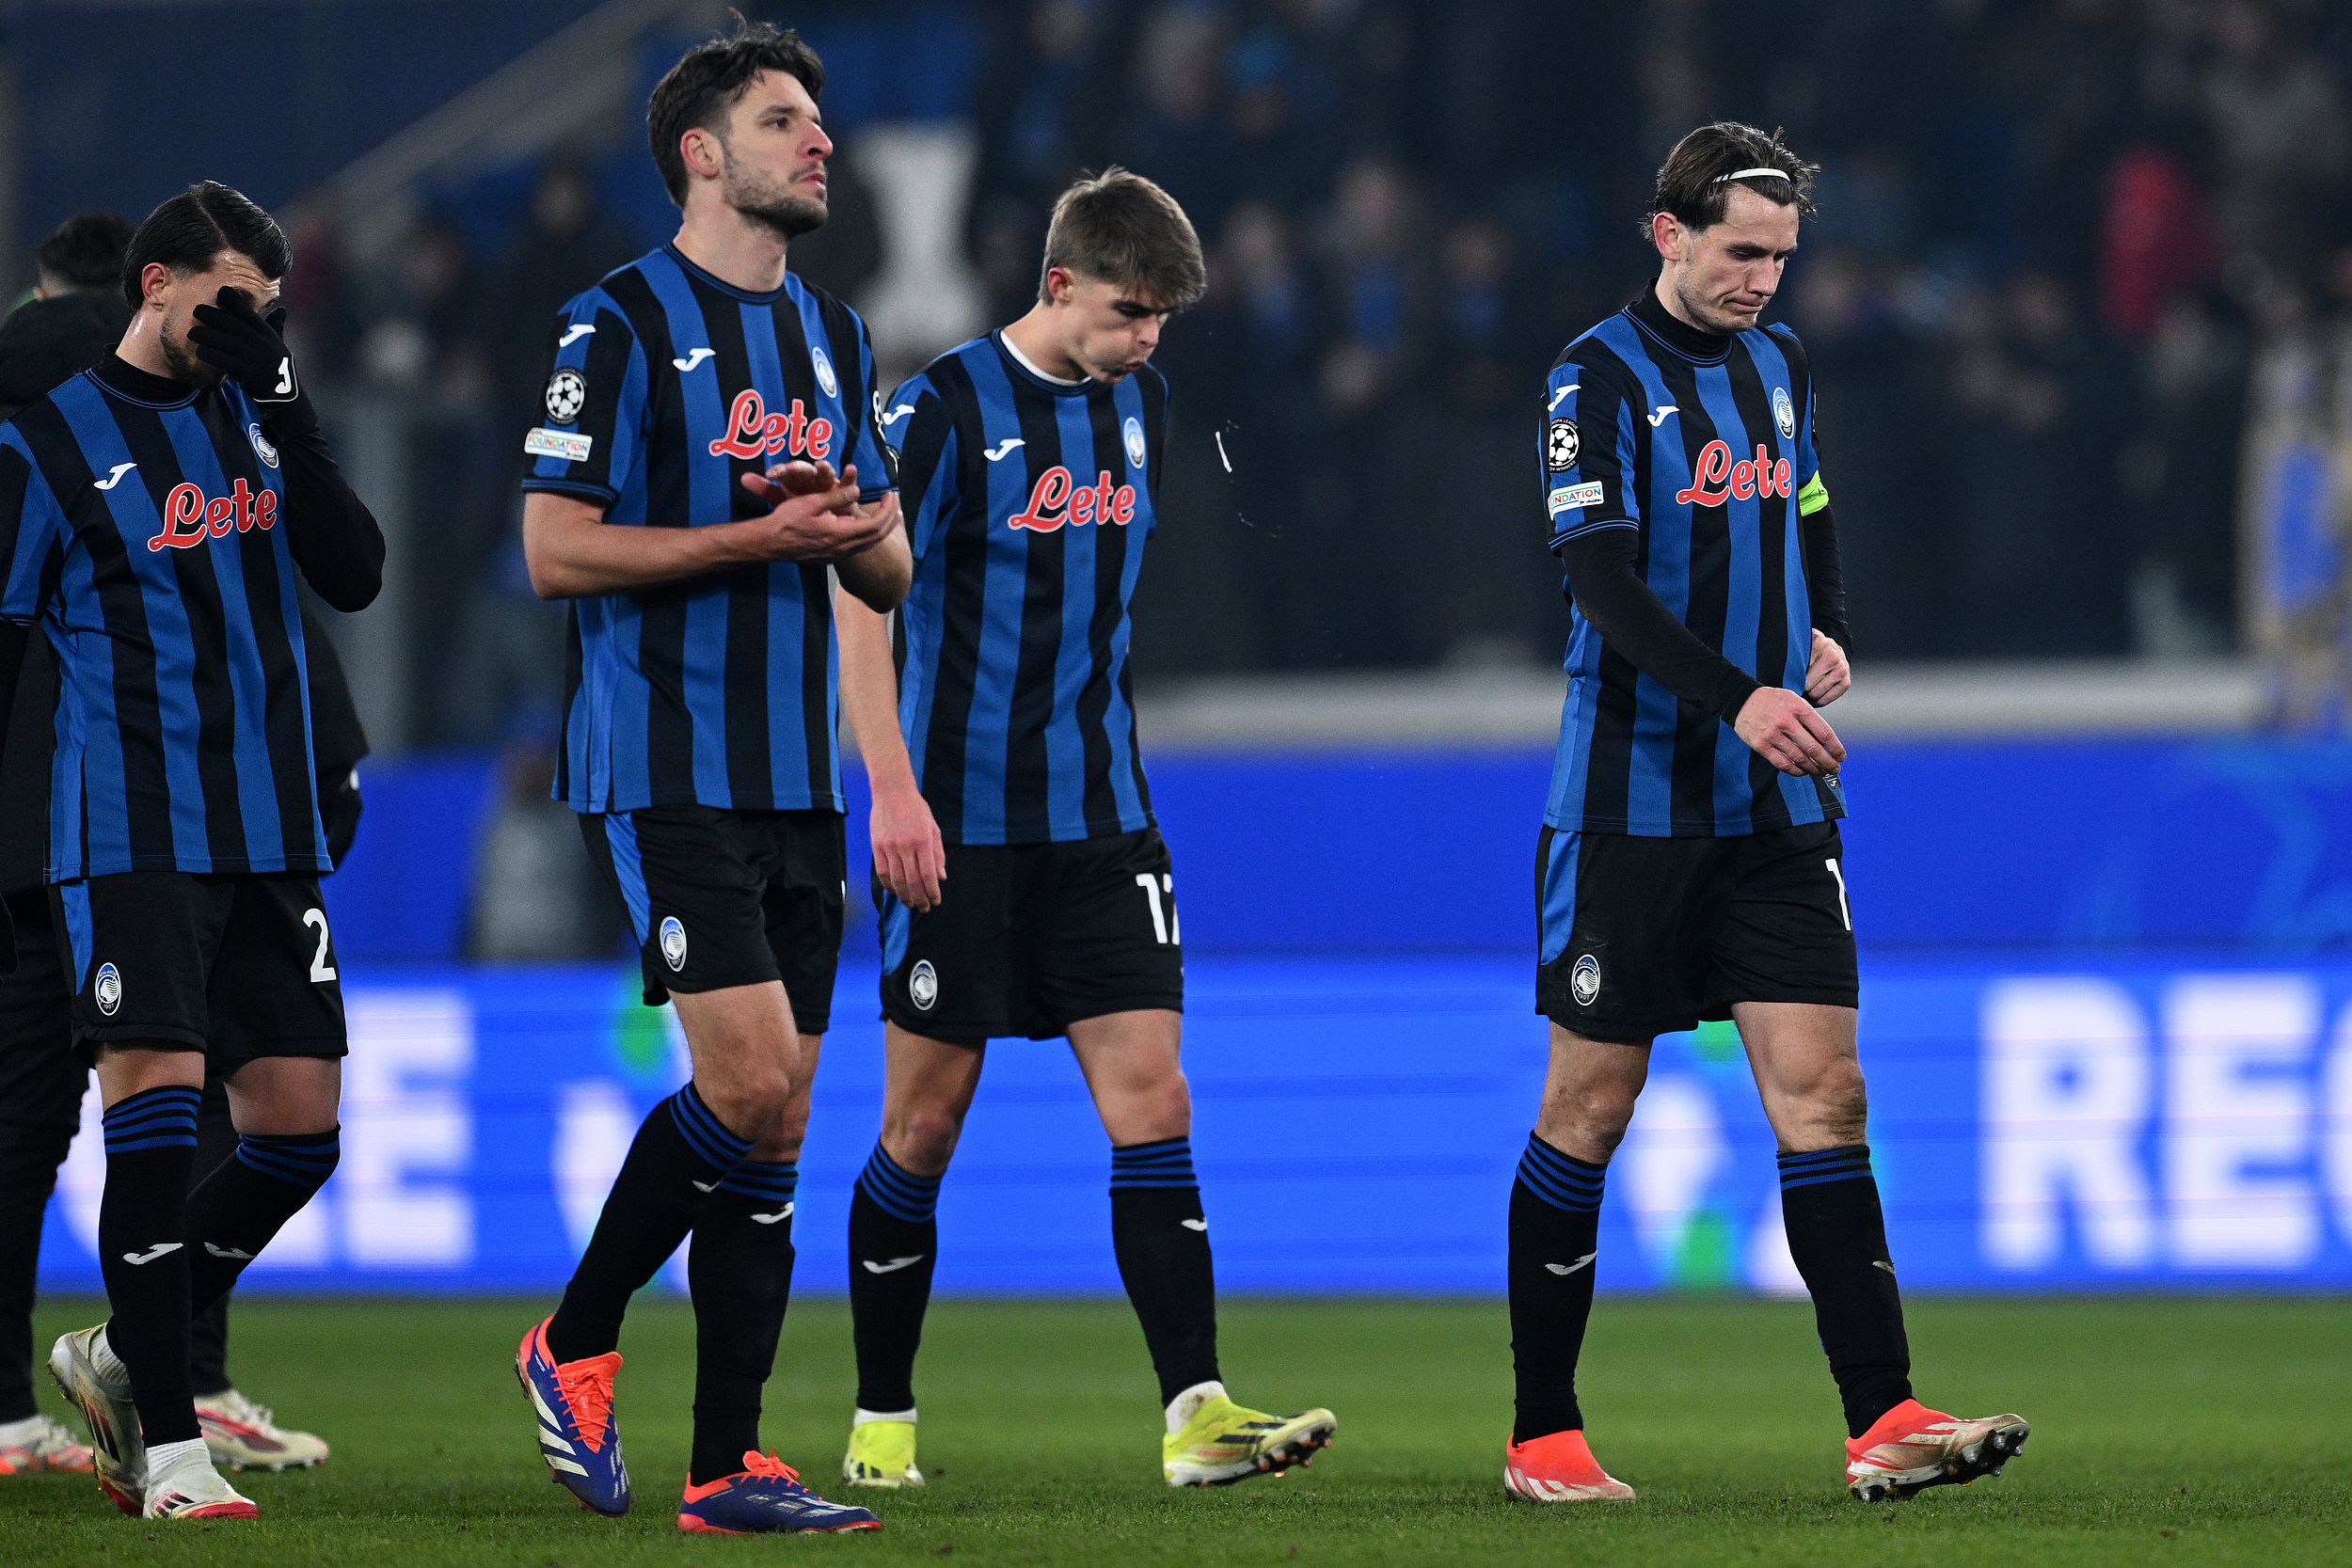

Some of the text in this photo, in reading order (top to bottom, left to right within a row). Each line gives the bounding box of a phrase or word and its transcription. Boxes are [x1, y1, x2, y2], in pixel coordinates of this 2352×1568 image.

[528, 435, 588, 451] FOUNDATION
[708, 388, 833, 460] Lete
[1008, 466, 1136, 533] Lete
[1552, 488, 1601, 505] NDATION
[1677, 439, 1792, 508] Lete
[147, 478, 278, 552] Lete
[1825, 858, 1852, 931] 1
[303, 908, 337, 983] 2
[1979, 974, 2352, 1271] RE
